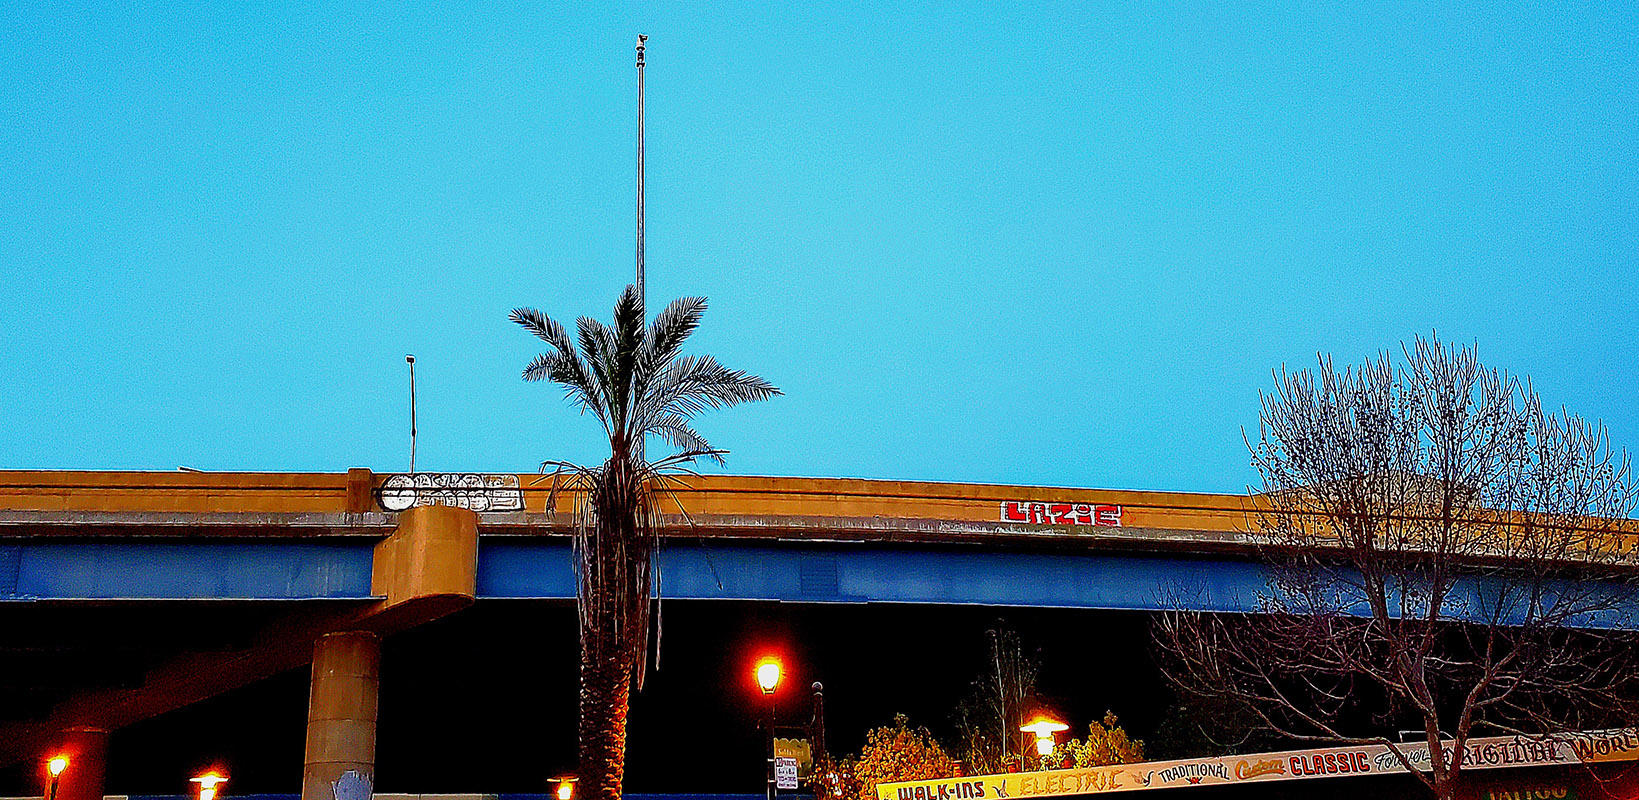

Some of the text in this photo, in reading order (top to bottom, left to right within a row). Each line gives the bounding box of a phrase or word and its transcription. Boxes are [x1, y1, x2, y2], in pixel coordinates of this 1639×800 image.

[897, 781, 984, 800] WALK-INS
[1019, 769, 1125, 796] ELECTRIC
[1158, 763, 1230, 783] TRADITIONAL
[1235, 759, 1286, 780] Custom
[1289, 752, 1370, 776] CLASSIC
[1374, 749, 1431, 771] Forver
